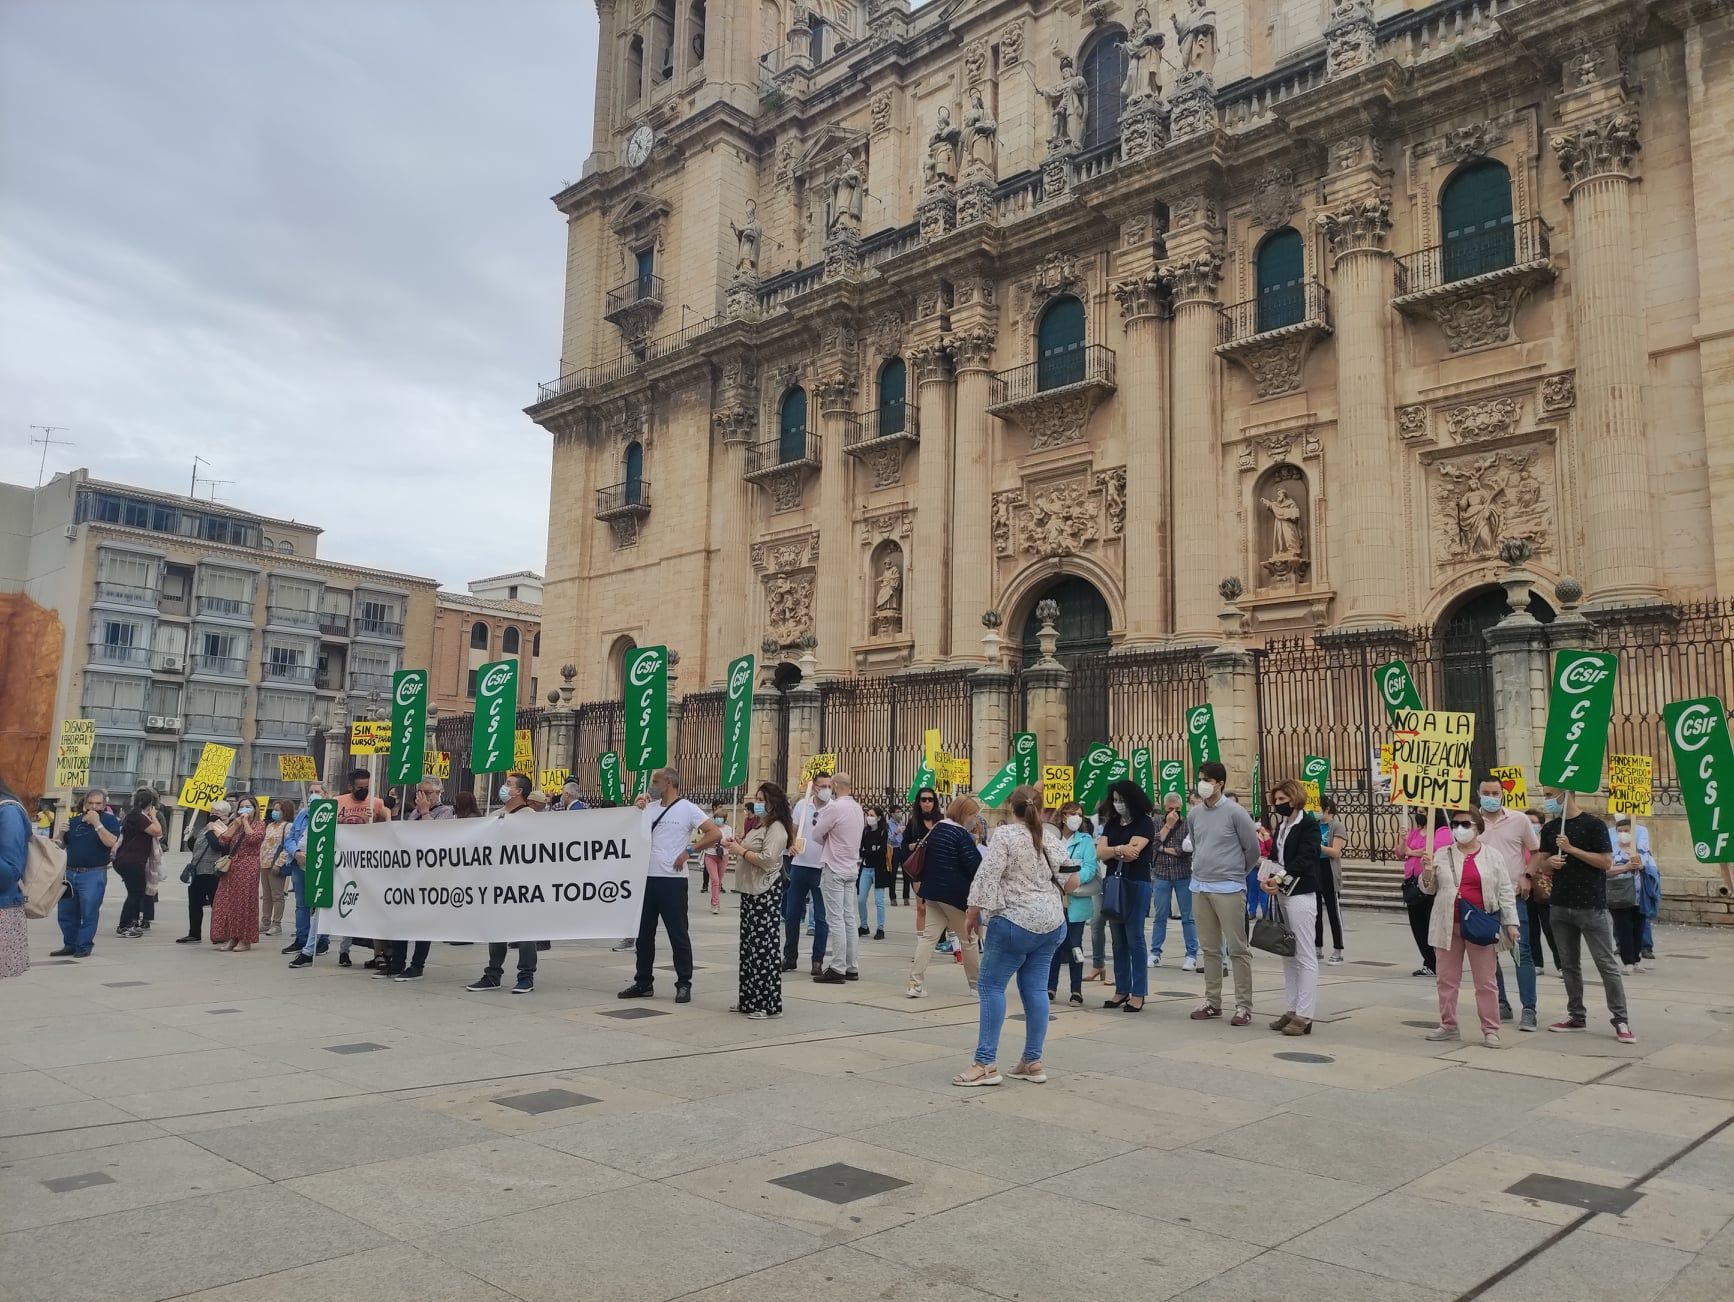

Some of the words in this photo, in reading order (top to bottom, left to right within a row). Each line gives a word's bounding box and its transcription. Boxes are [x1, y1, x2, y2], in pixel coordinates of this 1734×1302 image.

[354, 725, 371, 735] SIN
[485, 698, 502, 768] CSIF
[639, 689, 653, 766] CSIF
[1395, 711, 1419, 731] NO
[1424, 713, 1436, 731] A
[1446, 714, 1469, 735] LA
[351, 739, 376, 747] CURSOS
[399, 709, 415, 780] CSIF
[728, 701, 744, 783] CSIF
[1558, 700, 1590, 783] CSIF
[1417, 765, 1429, 775] DE
[1437, 768, 1449, 778] LA
[192, 781, 224, 795] SOMOS
[1079, 770, 1100, 804] CSI
[1403, 773, 1468, 803] UPMJ
[1616, 801, 1648, 814] UPMJ
[1699, 755, 1729, 857] CSIF
[335, 849, 411, 868] UNIVERSIDAD
[417, 846, 493, 868] POPULAR
[500, 839, 632, 865] MUNICIPAL
[314, 836, 326, 903] CSIF
[384, 887, 415, 904] CON
[419, 887, 473, 908] TOD@S
[478, 886, 488, 904] Y
[494, 885, 545, 904] PARA
[552, 880, 632, 903] TOD@S
